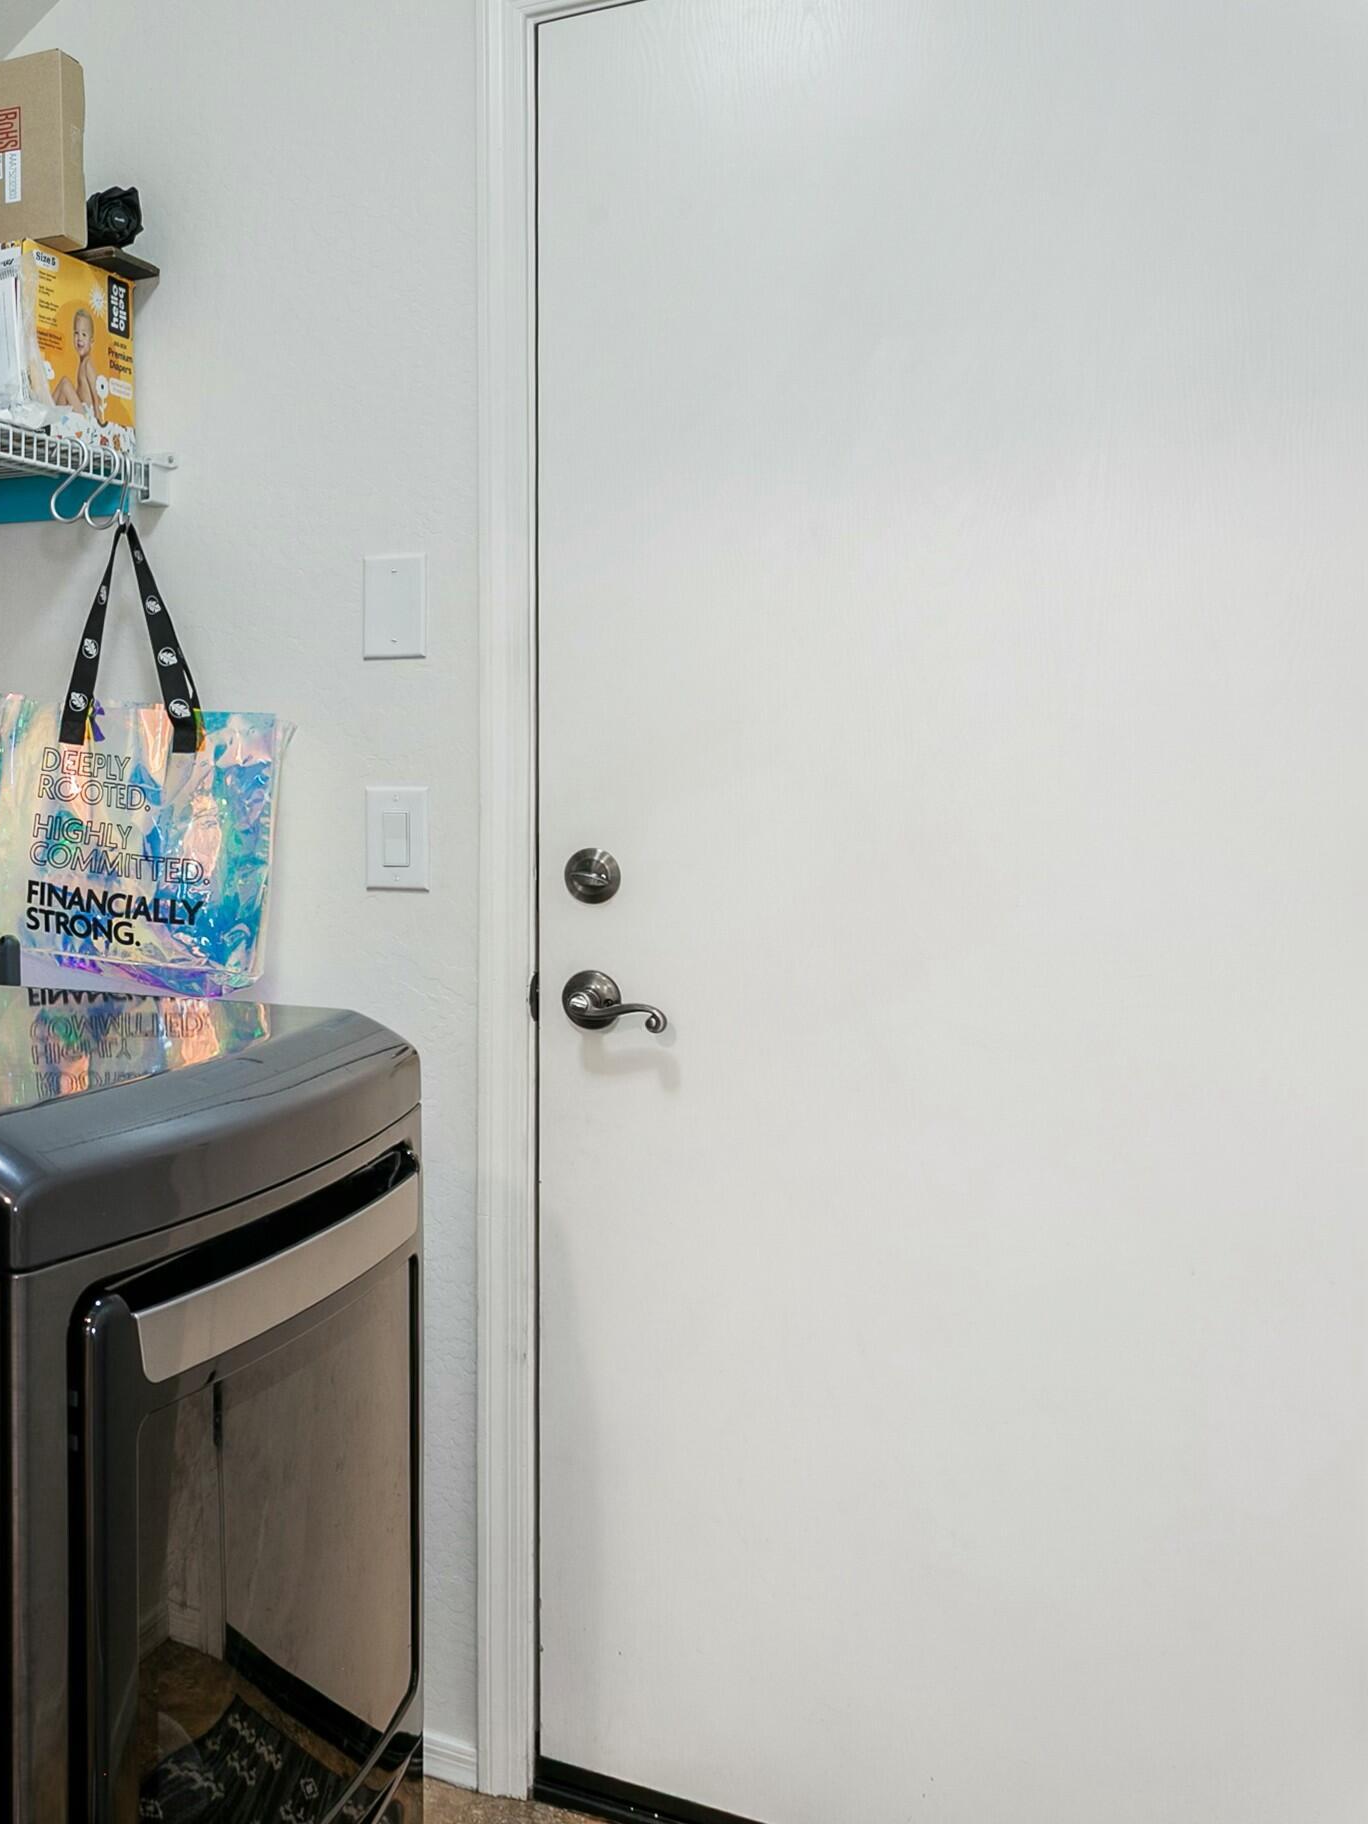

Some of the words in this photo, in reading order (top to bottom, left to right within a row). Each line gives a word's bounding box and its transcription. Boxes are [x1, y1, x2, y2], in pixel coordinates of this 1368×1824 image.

[110, 283, 119, 330] hello
[118, 286, 128, 332] bello
[108, 347, 133, 363] Premium
[109, 360, 132, 375] Diapers
[41, 747, 132, 781] DEEPLY
[37, 775, 151, 812] ROOTED.
[32, 813, 132, 850] HIGHLY
[29, 843, 210, 886] COMMITTED.
[27, 880, 204, 926] FINANCIALLY
[26, 907, 142, 947] STRONG.
